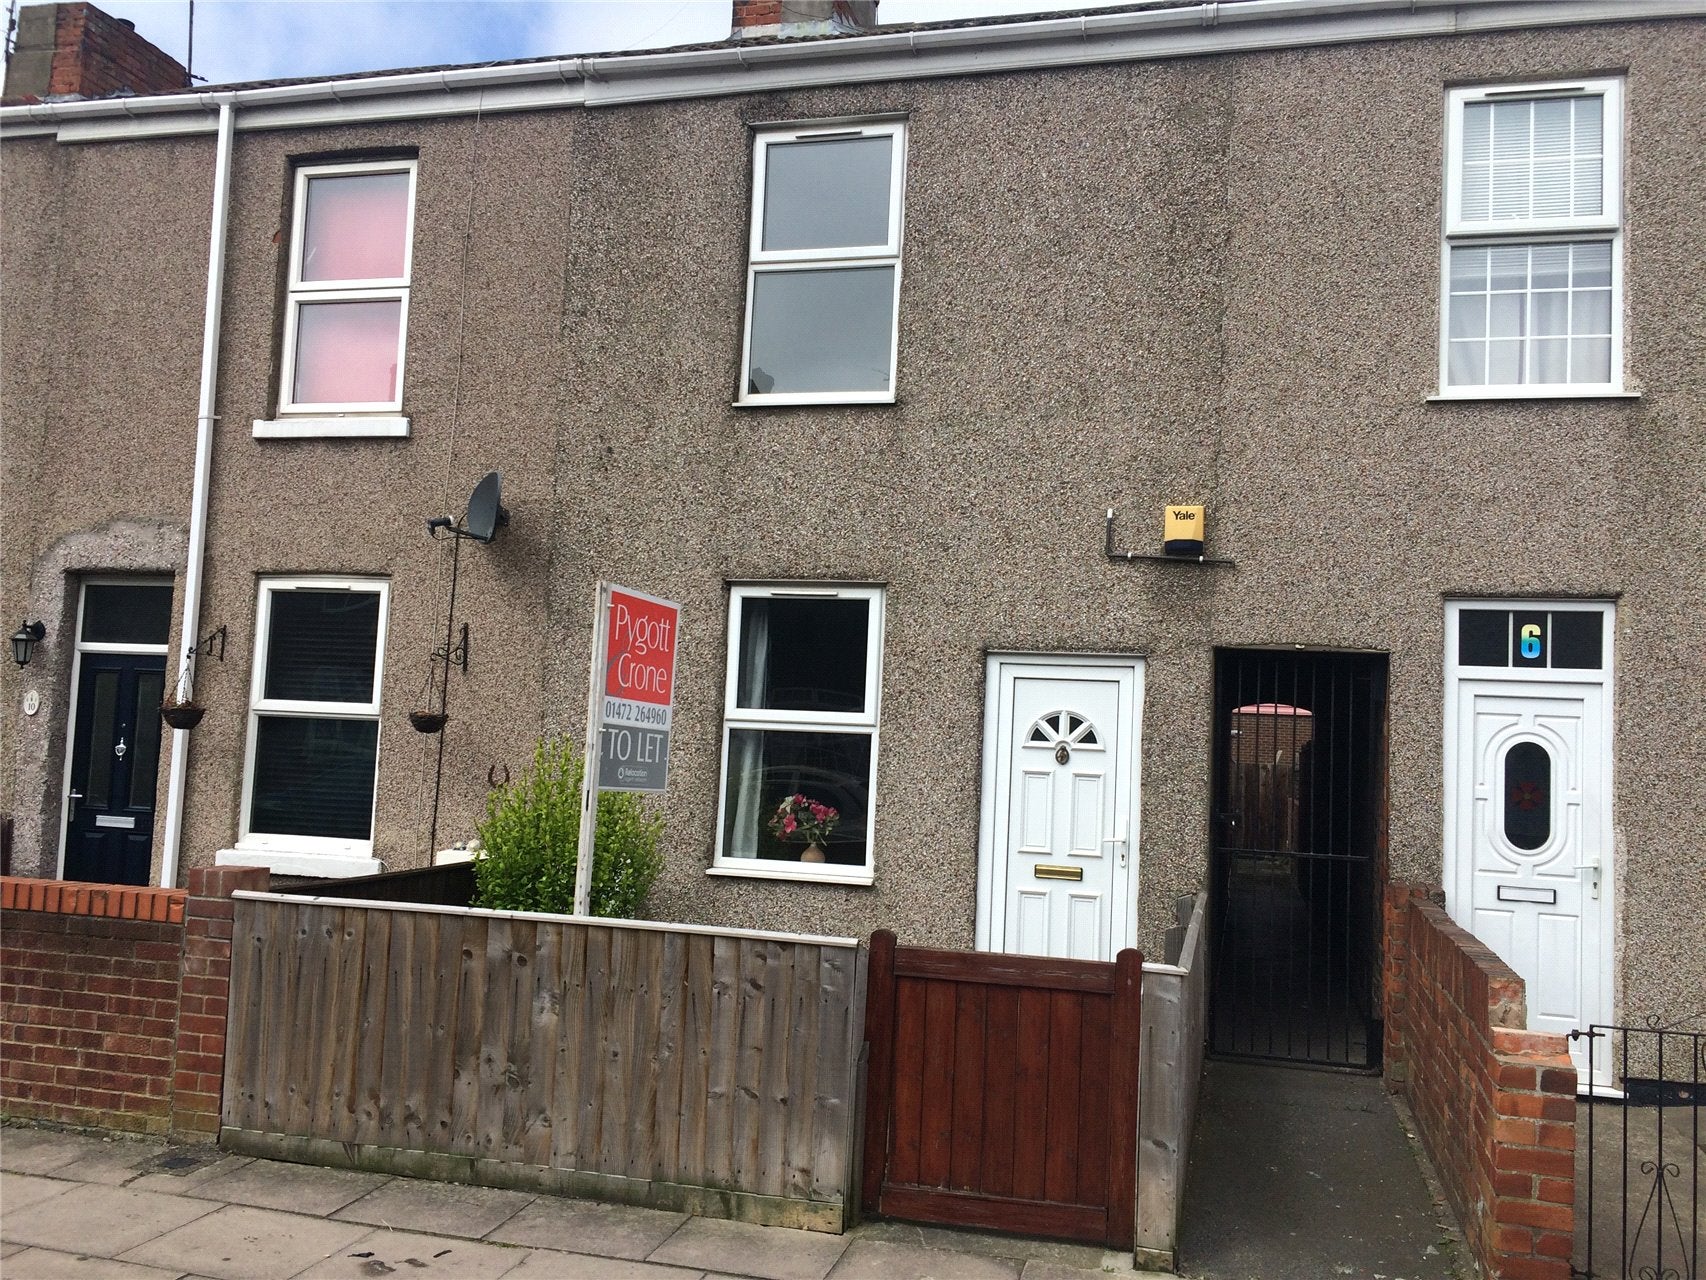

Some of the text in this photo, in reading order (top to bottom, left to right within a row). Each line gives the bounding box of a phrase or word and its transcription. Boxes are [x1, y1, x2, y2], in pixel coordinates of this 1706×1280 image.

[1172, 510, 1195, 520] Yale
[615, 604, 670, 655] Pygott
[1520, 623, 1541, 659] 6
[618, 653, 667, 694] Crone
[28, 703, 36, 711] 10
[605, 700, 667, 725] 01472 264960
[608, 728, 664, 763] TO LET
